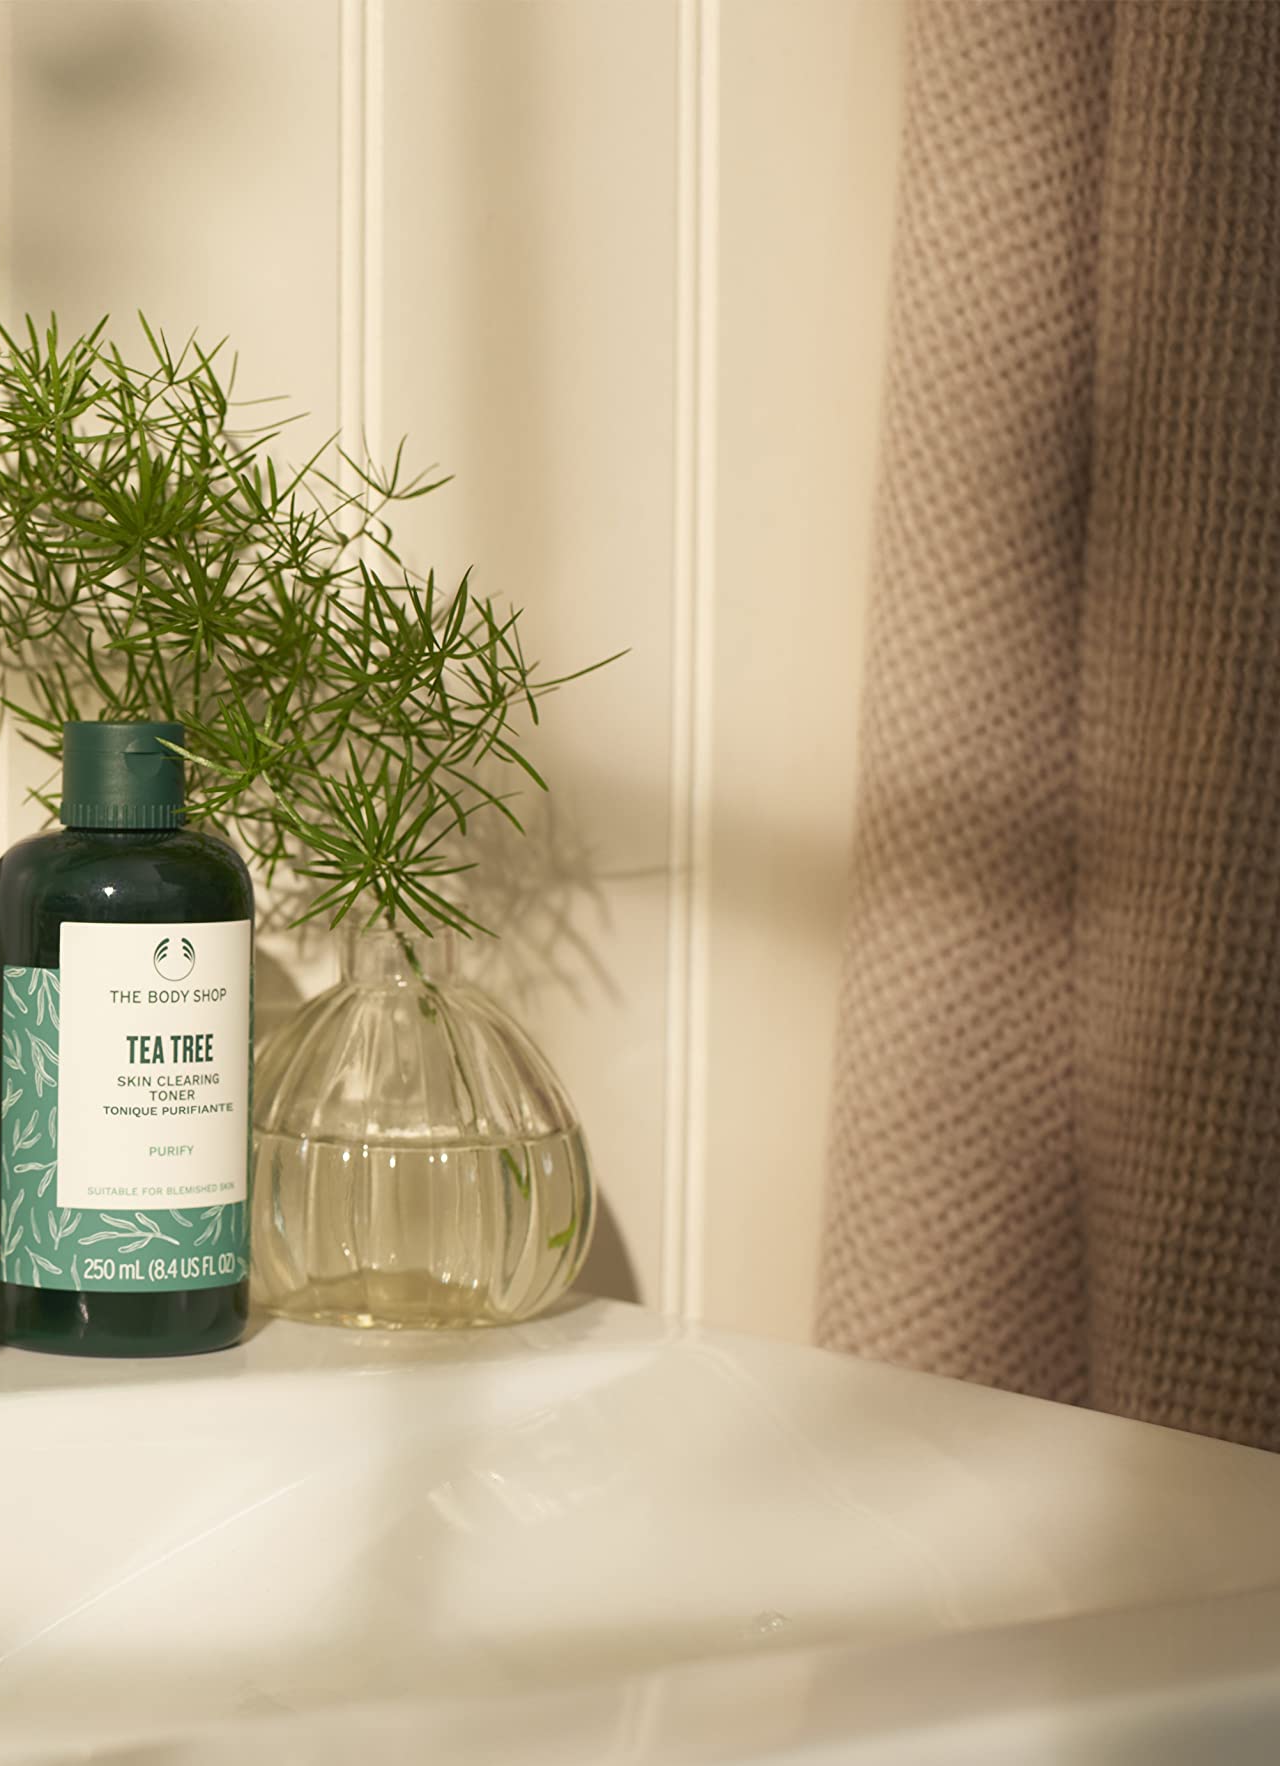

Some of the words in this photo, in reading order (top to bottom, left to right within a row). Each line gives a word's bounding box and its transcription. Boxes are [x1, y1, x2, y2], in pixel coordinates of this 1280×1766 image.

[110, 991, 142, 1004] THE
[148, 990, 189, 1003] BODY
[194, 988, 227, 1002] SHOP
[127, 1035, 164, 1064] TEA
[170, 1033, 214, 1063] TREE
[117, 1076, 152, 1087] SKIN
[157, 1074, 220, 1086] CLEARING
[149, 1090, 195, 1101] TONER
[103, 1106, 157, 1117] TONIQUE
[162, 1103, 233, 1115] PURIFIANTE
[149, 1146, 194, 1157] PURIFY
[88, 1187, 137, 1196] SUITABLE
[142, 1187, 164, 1196] FOR
[166, 1184, 217, 1195] BLEMISHED
[220, 1182, 235, 1192] SKIN
[84, 1259, 115, 1280] 250
[119, 1259, 144, 1281] mL
[149, 1258, 177, 1282] (8.4
[181, 1257, 200, 1277] US
[203, 1256, 217, 1275] FL
